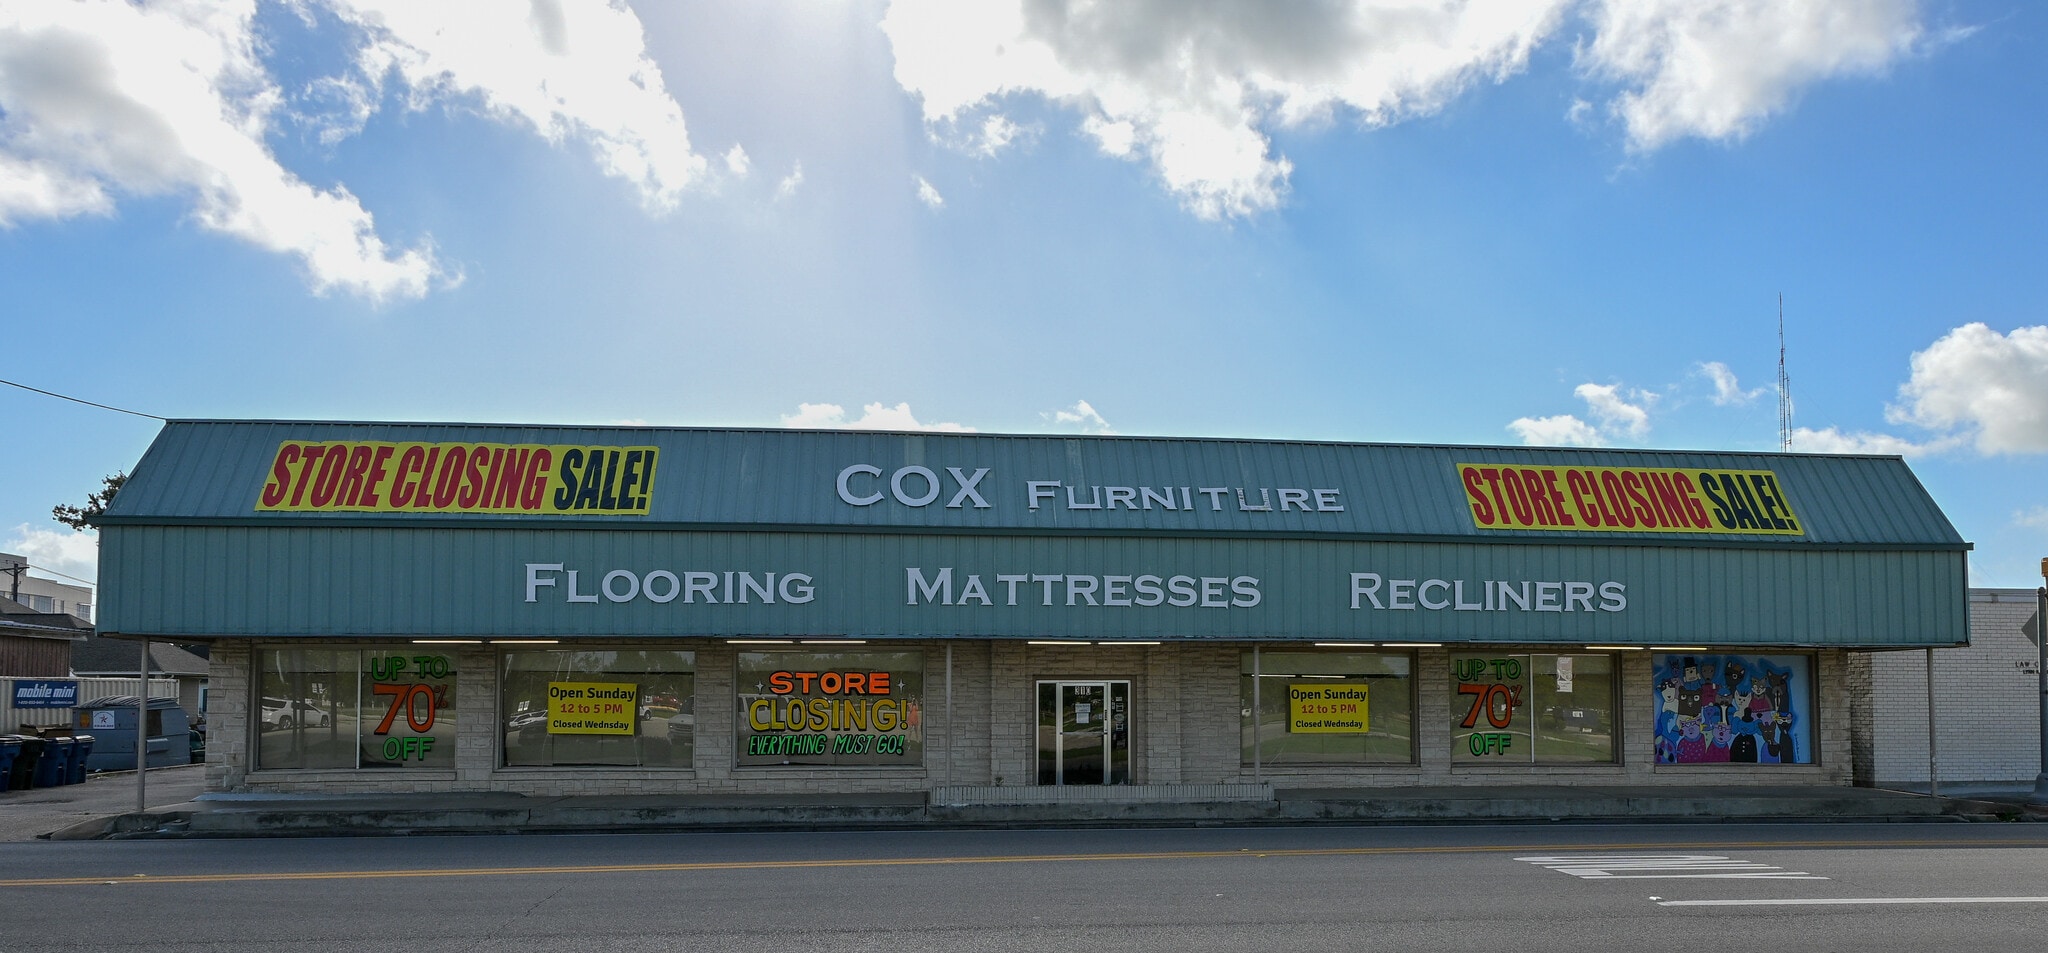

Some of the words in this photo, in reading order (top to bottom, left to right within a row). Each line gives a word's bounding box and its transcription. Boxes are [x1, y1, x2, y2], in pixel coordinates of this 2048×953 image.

[262, 444, 394, 507] STORE
[389, 446, 552, 509] CLOSING
[553, 448, 655, 511] SALE!
[836, 464, 992, 508] COX
[1026, 480, 1345, 512] FURNITURE
[1463, 467, 1576, 526] STORE
[1567, 469, 1712, 529] CLOSING
[1699, 472, 1798, 531] SALE!
[524, 562, 815, 605] FLOORING
[905, 567, 1262, 609] MATTRESSES
[1350, 573, 1627, 613] RECLINERS
[371, 656, 406, 681] UP
[413, 656, 448, 679] TO
[1456, 659, 1486, 681] UP
[1490, 658, 1521, 680] TO
[17, 684, 52, 698] mobile
[53, 686, 76, 698] mini
[550, 687, 583, 700] Open
[587, 687, 635, 702] Sunday
[769, 670, 891, 696] STORE
[1291, 689, 1321, 702] Open
[1324, 689, 1366, 702] Sunday
[1458, 682, 1522, 729] 70%
[373, 683, 448, 735] 70%
[560, 704, 574, 713] 12
[578, 704, 590, 713] to
[594, 704, 600, 713] 5
[604, 704, 623, 714] PM
[749, 698, 908, 732] CLOSING!
[1302, 705, 1314, 713] 12
[1317, 705, 1328, 713] to
[1331, 705, 1337, 713] 5
[1341, 704, 1356, 713] PM
[553, 720, 582, 728] Closed
[585, 720, 629, 730] Wednsday
[1296, 720, 1322, 728] Closed
[1324, 720, 1363, 729] Wednsday
[383, 737, 435, 761] OFF
[748, 734, 827, 756] EVERYTHING
[832, 734, 875, 755] MUST
[876, 735, 905, 756] GO!
[1469, 733, 1512, 756] OFF
